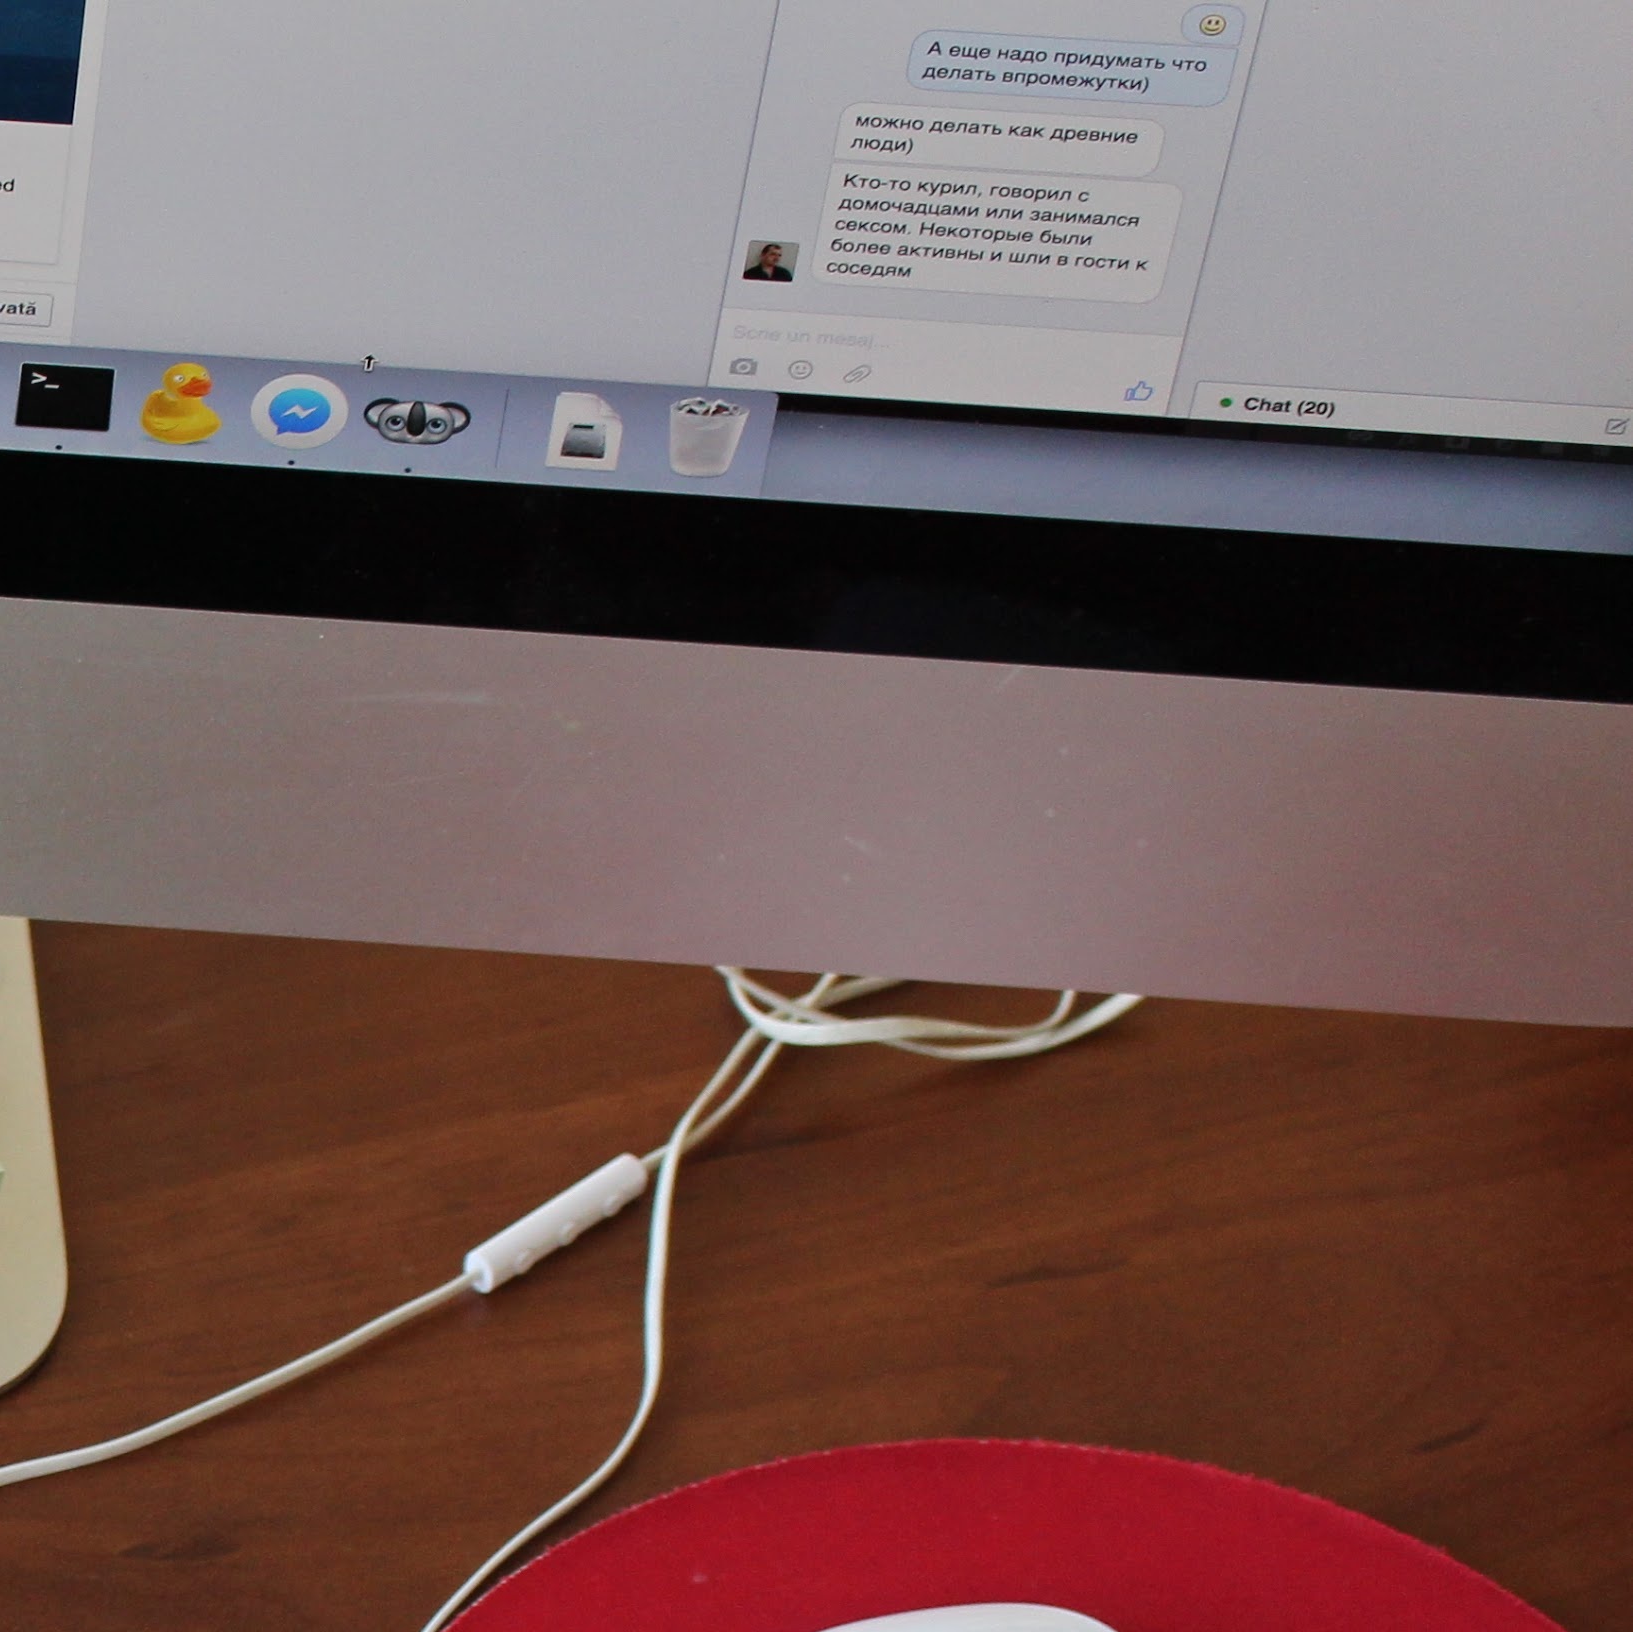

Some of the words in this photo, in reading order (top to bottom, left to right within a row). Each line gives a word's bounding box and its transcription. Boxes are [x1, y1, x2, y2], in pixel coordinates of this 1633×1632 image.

[949, 45, 990, 59] еще
[997, 48, 1047, 63] надо
[1053, 52, 1165, 69] придумать
[1172, 59, 1206, 71] что
[921, 66, 995, 81] делать
[1002, 71, 1149, 93] впромежутки)
[855, 115, 924, 130] можно
[928, 120, 1001, 135] делать
[1008, 125, 1044, 137] как
[1049, 128, 1138, 143] древние
[850, 137, 913, 155] люди)
[843, 173, 911, 191] Кто-то
[917, 181, 981, 197] курил,
[989, 186, 1071, 202] говорил
[837, 198, 979, 216] домочадцами
[985, 207, 1023, 219] или
[1029, 210, 1139, 226] занимался
[834, 219, 910, 234] сексом.
[919, 221, 1033, 243] Некоторые
[1039, 229, 1092, 245] были
[830, 237, 891, 254] более
[896, 245, 984, 260] активны
[989, 251, 1002, 261] и
[1008, 252, 1050, 264] шли
[1056, 255, 1068, 266] в
[1074, 256, 1129, 269] гости
[826, 262, 911, 277] соседям
[1243, 397, 1291, 412] Chat
[1296, 400, 1334, 418] (20)
